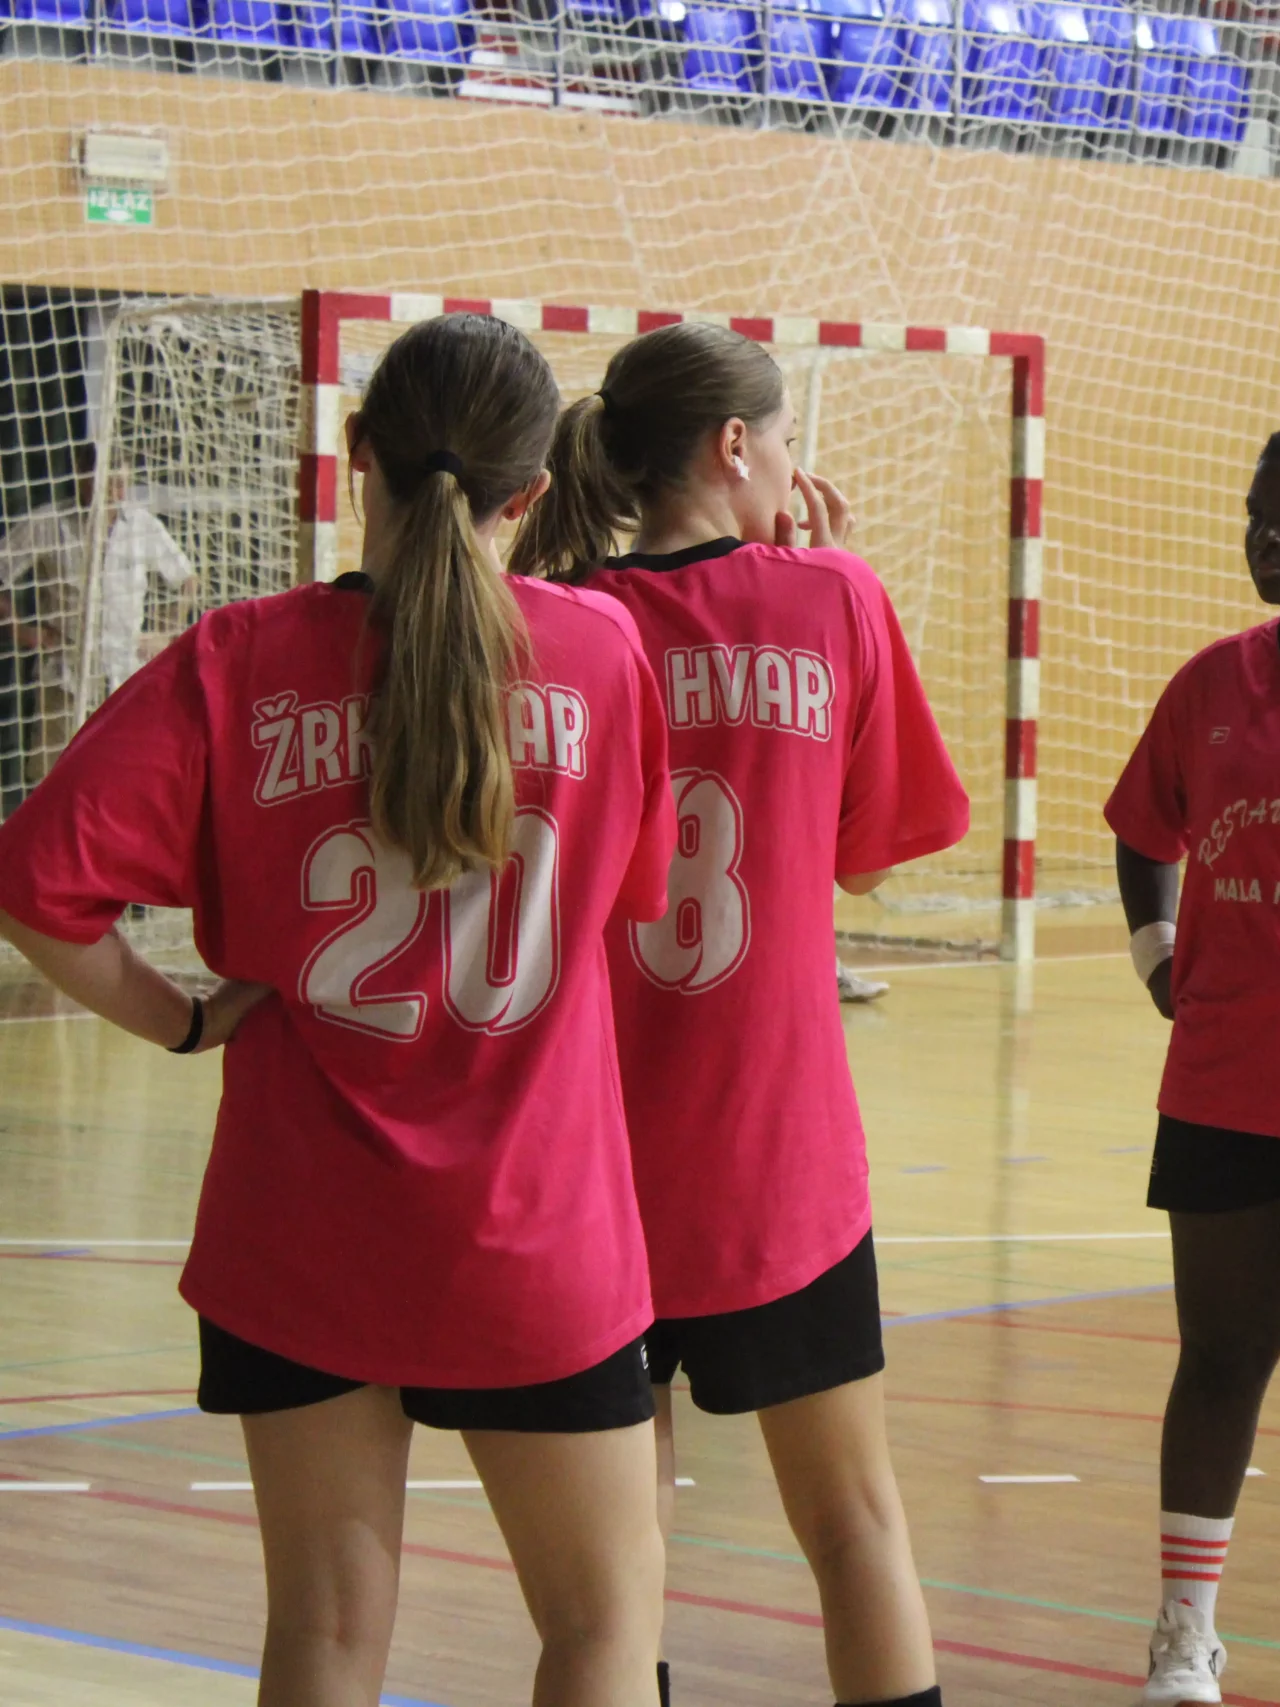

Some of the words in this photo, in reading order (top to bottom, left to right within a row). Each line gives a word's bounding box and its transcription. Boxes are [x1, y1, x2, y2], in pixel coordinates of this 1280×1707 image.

[665, 644, 835, 741] HVAR
[299, 804, 561, 1042] 20
[628, 767, 750, 994] 8
[1214, 878, 1262, 903] MALA
